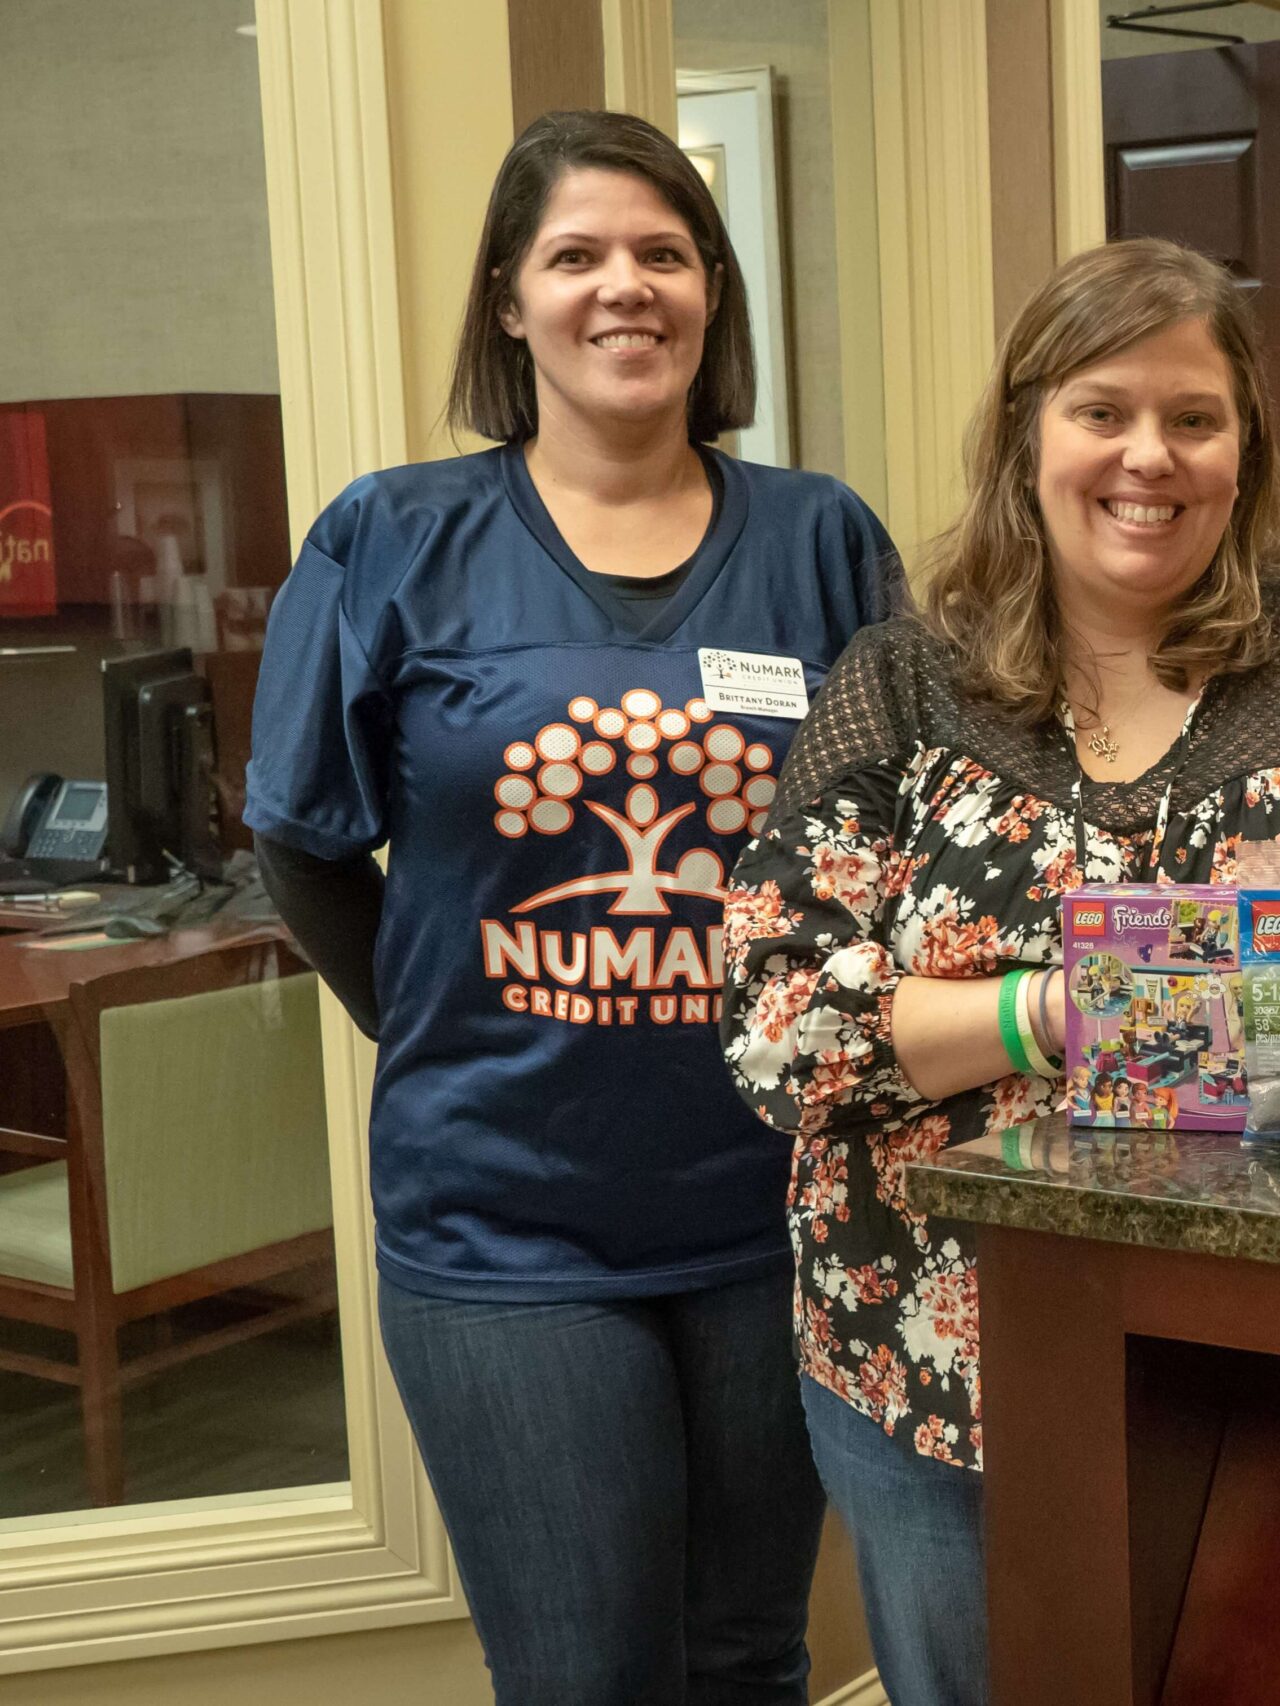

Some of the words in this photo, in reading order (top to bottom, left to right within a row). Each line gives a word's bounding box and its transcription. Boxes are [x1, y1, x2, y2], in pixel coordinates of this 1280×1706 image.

[1075, 912, 1103, 925] LEGO
[1112, 905, 1172, 933] Friends
[502, 984, 638, 1026] CREDIT
[650, 994, 723, 1025] UNI
[1254, 1019, 1270, 1031] 58
